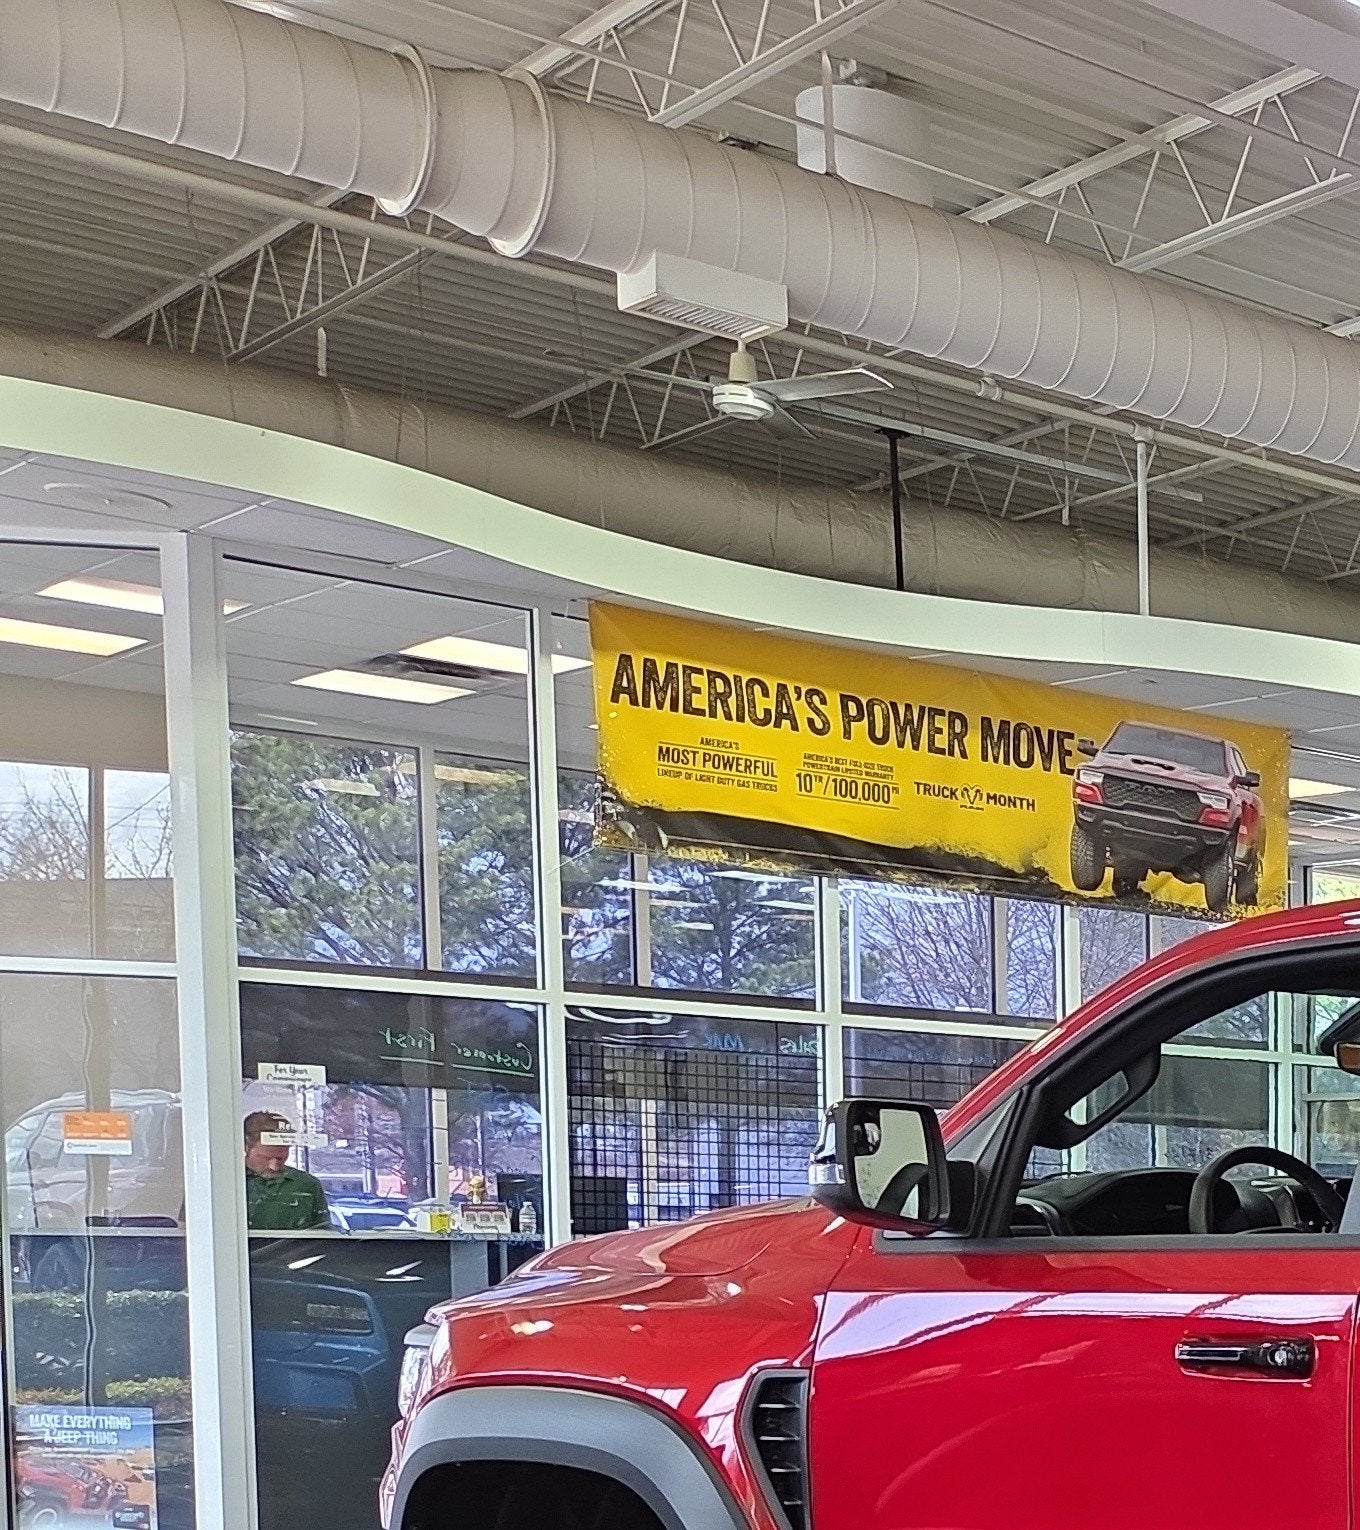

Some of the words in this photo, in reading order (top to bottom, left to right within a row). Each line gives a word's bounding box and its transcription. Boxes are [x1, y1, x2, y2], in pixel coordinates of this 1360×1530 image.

[610, 653, 831, 736] AMERICA'S
[839, 693, 968, 760] POWER
[699, 737, 740, 750] AMERICA'S
[658, 745, 699, 766] MOST
[702, 751, 778, 778] POWERFUL
[914, 781, 960, 800] TRUCK
[986, 792, 1036, 812] MONTH
[29, 1413, 61, 1428] MAKE
[62, 1414, 132, 1431] EVERYTHING
[85, 1431, 119, 1445] THING
